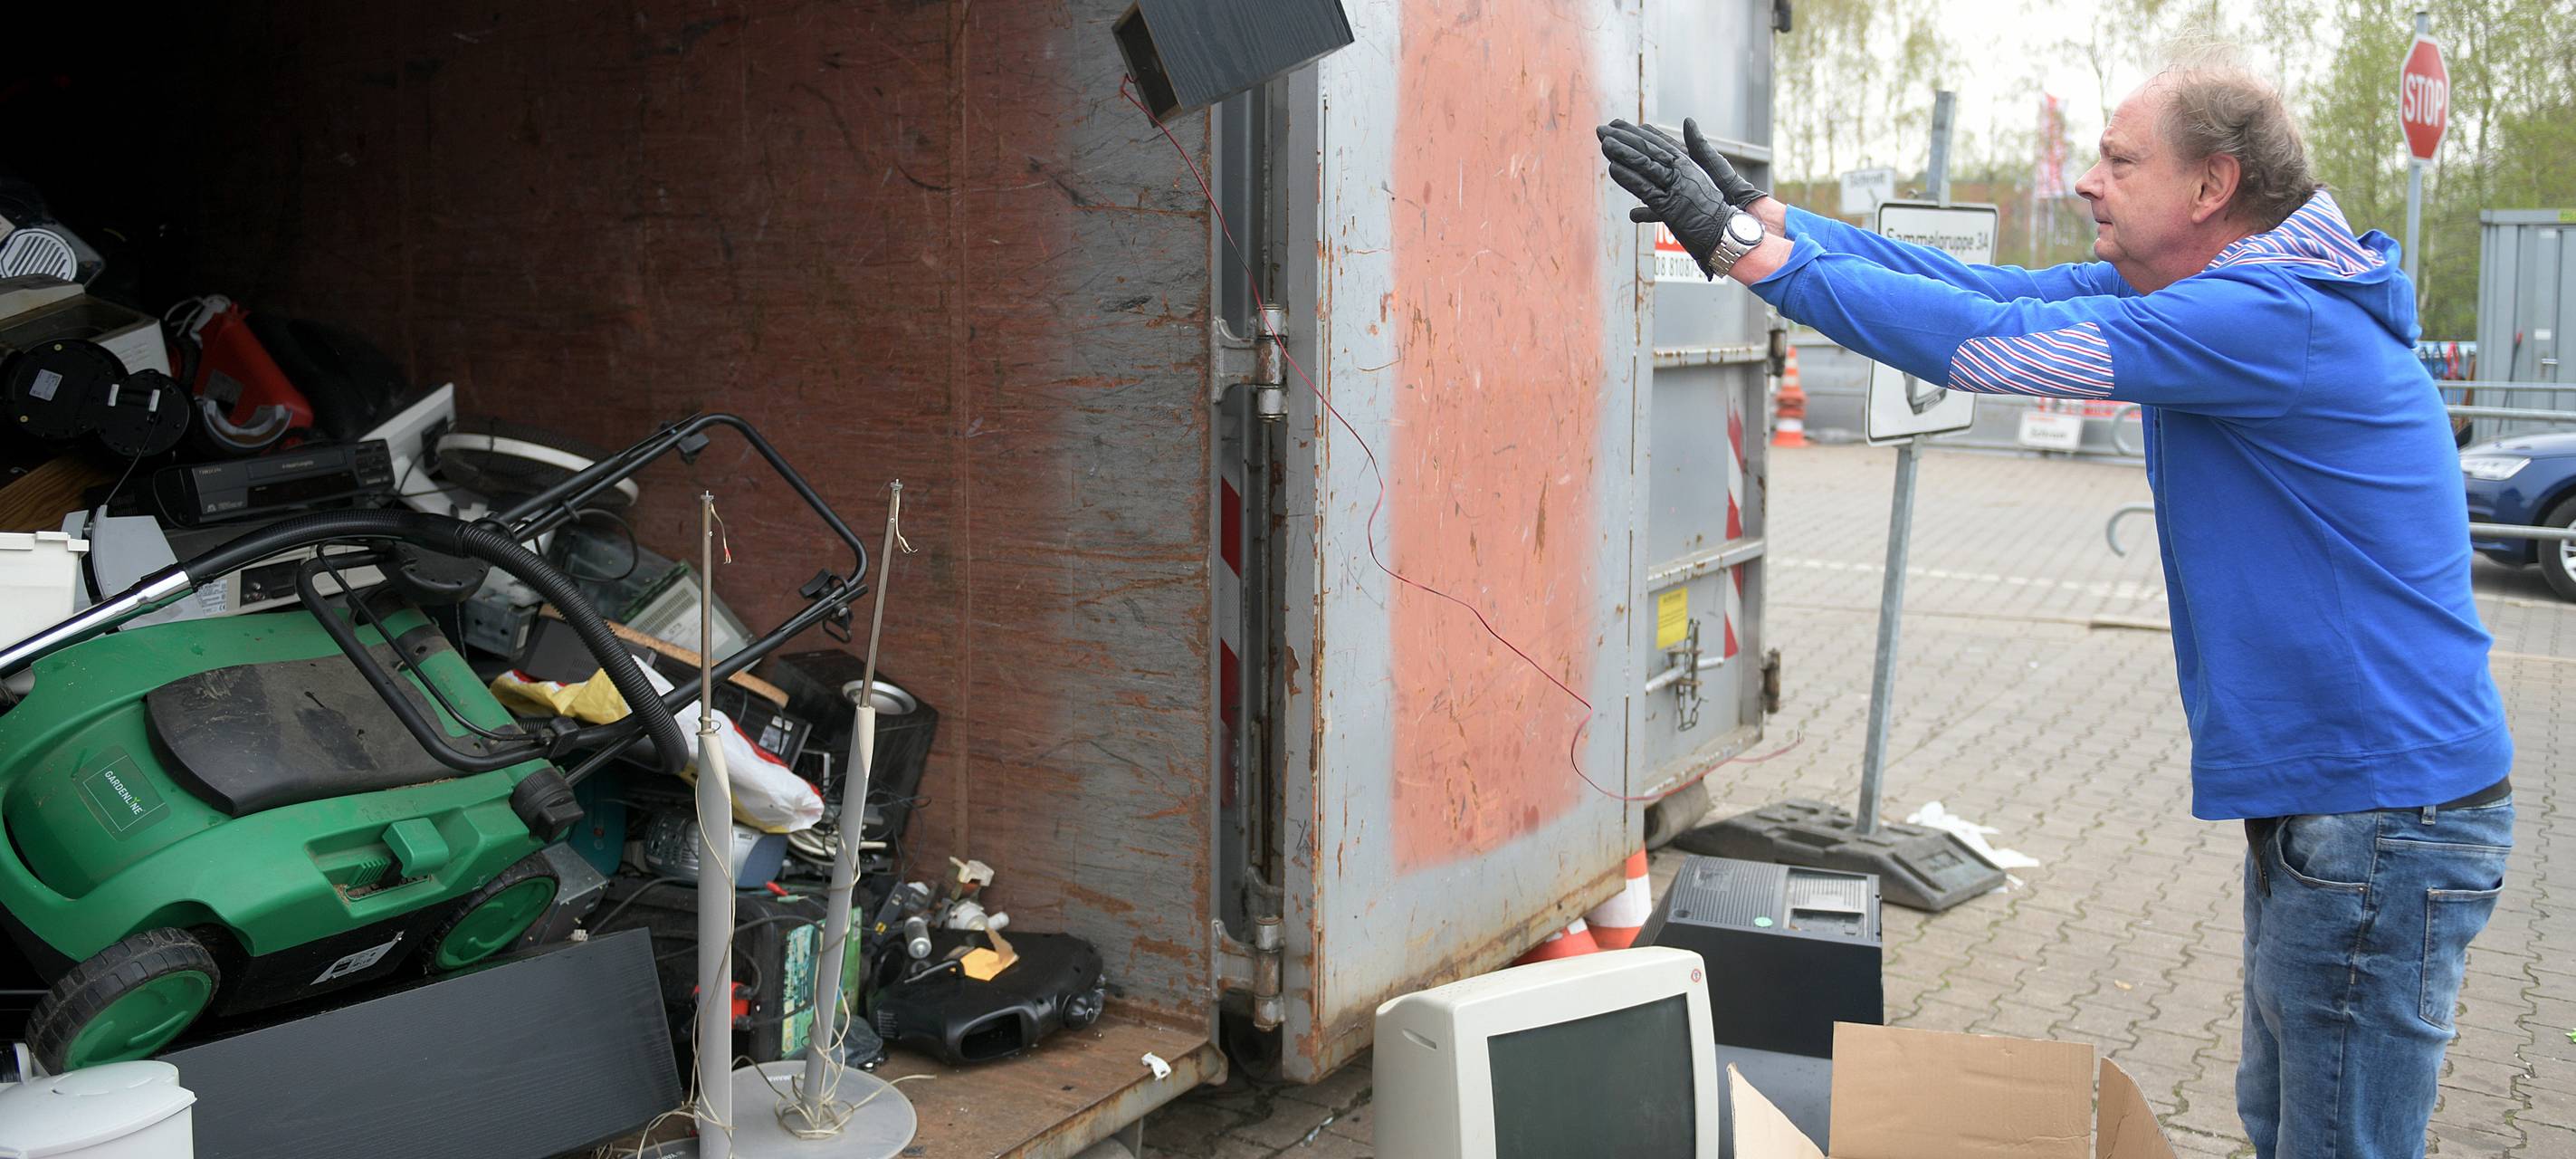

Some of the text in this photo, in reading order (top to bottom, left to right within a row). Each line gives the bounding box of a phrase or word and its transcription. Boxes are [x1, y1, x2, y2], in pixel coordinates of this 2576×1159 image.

[2404, 72, 2445, 127] STOP
[1977, 231, 1989, 250] 3A
[104, 771, 144, 815] GARDENLINE
